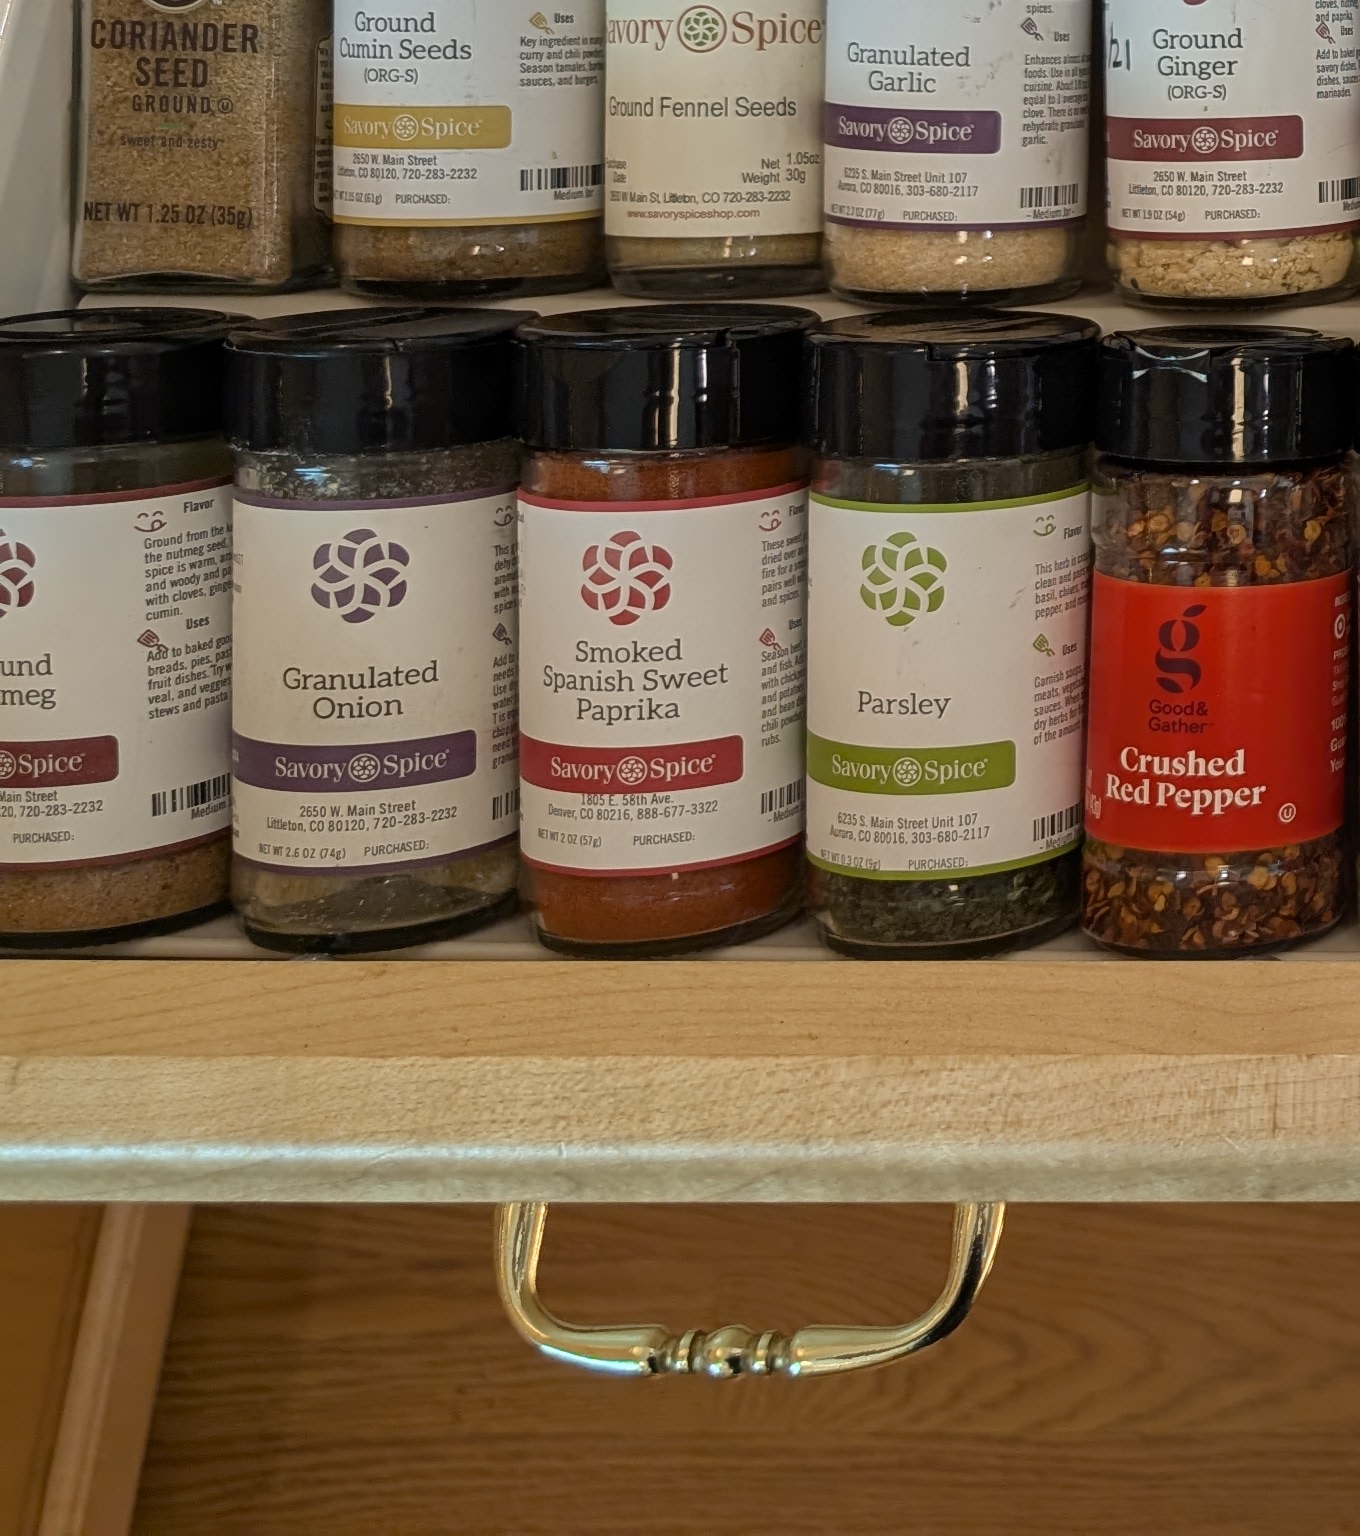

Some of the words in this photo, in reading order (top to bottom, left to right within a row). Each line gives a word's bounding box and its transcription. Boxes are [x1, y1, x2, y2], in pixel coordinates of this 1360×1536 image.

[90, 19, 259, 54] CORIANDER
[354, 12, 437, 34] Ground
[731, 12, 823, 45] Spice
[340, 39, 394, 60] Cumin
[398, 39, 473, 60] Seeds
[1152, 29, 1244, 50] Ground
[846, 42, 971, 69] Granulated
[1156, 57, 1239, 80] Ginger
[134, 57, 210, 88] SEED
[363, 69, 419, 85] (ORG-S)
[867, 70, 937, 94] Garlic
[132, 94, 212, 114] GROUND
[609, 97, 654, 118] Ground
[659, 97, 729, 118] Fennel
[734, 96, 797, 118] Seeds
[83, 201, 112, 223] NET
[116, 202, 140, 224] WT
[146, 203, 180, 224] 1.25
[184, 204, 209, 224] OZ
[211, 204, 253, 229] (35g)
[575, 639, 683, 663] Smoked
[282, 660, 439, 693] Granulated
[542, 670, 635, 694] Spanish
[642, 663, 729, 692] Sweet
[312, 697, 404, 721] Onion
[576, 696, 681, 725] Paprika
[857, 690, 952, 719] Parsley
[1119, 745, 1246, 779] Crushed
[1105, 773, 1152, 807] Red
[1156, 783, 1267, 816] Pepper
